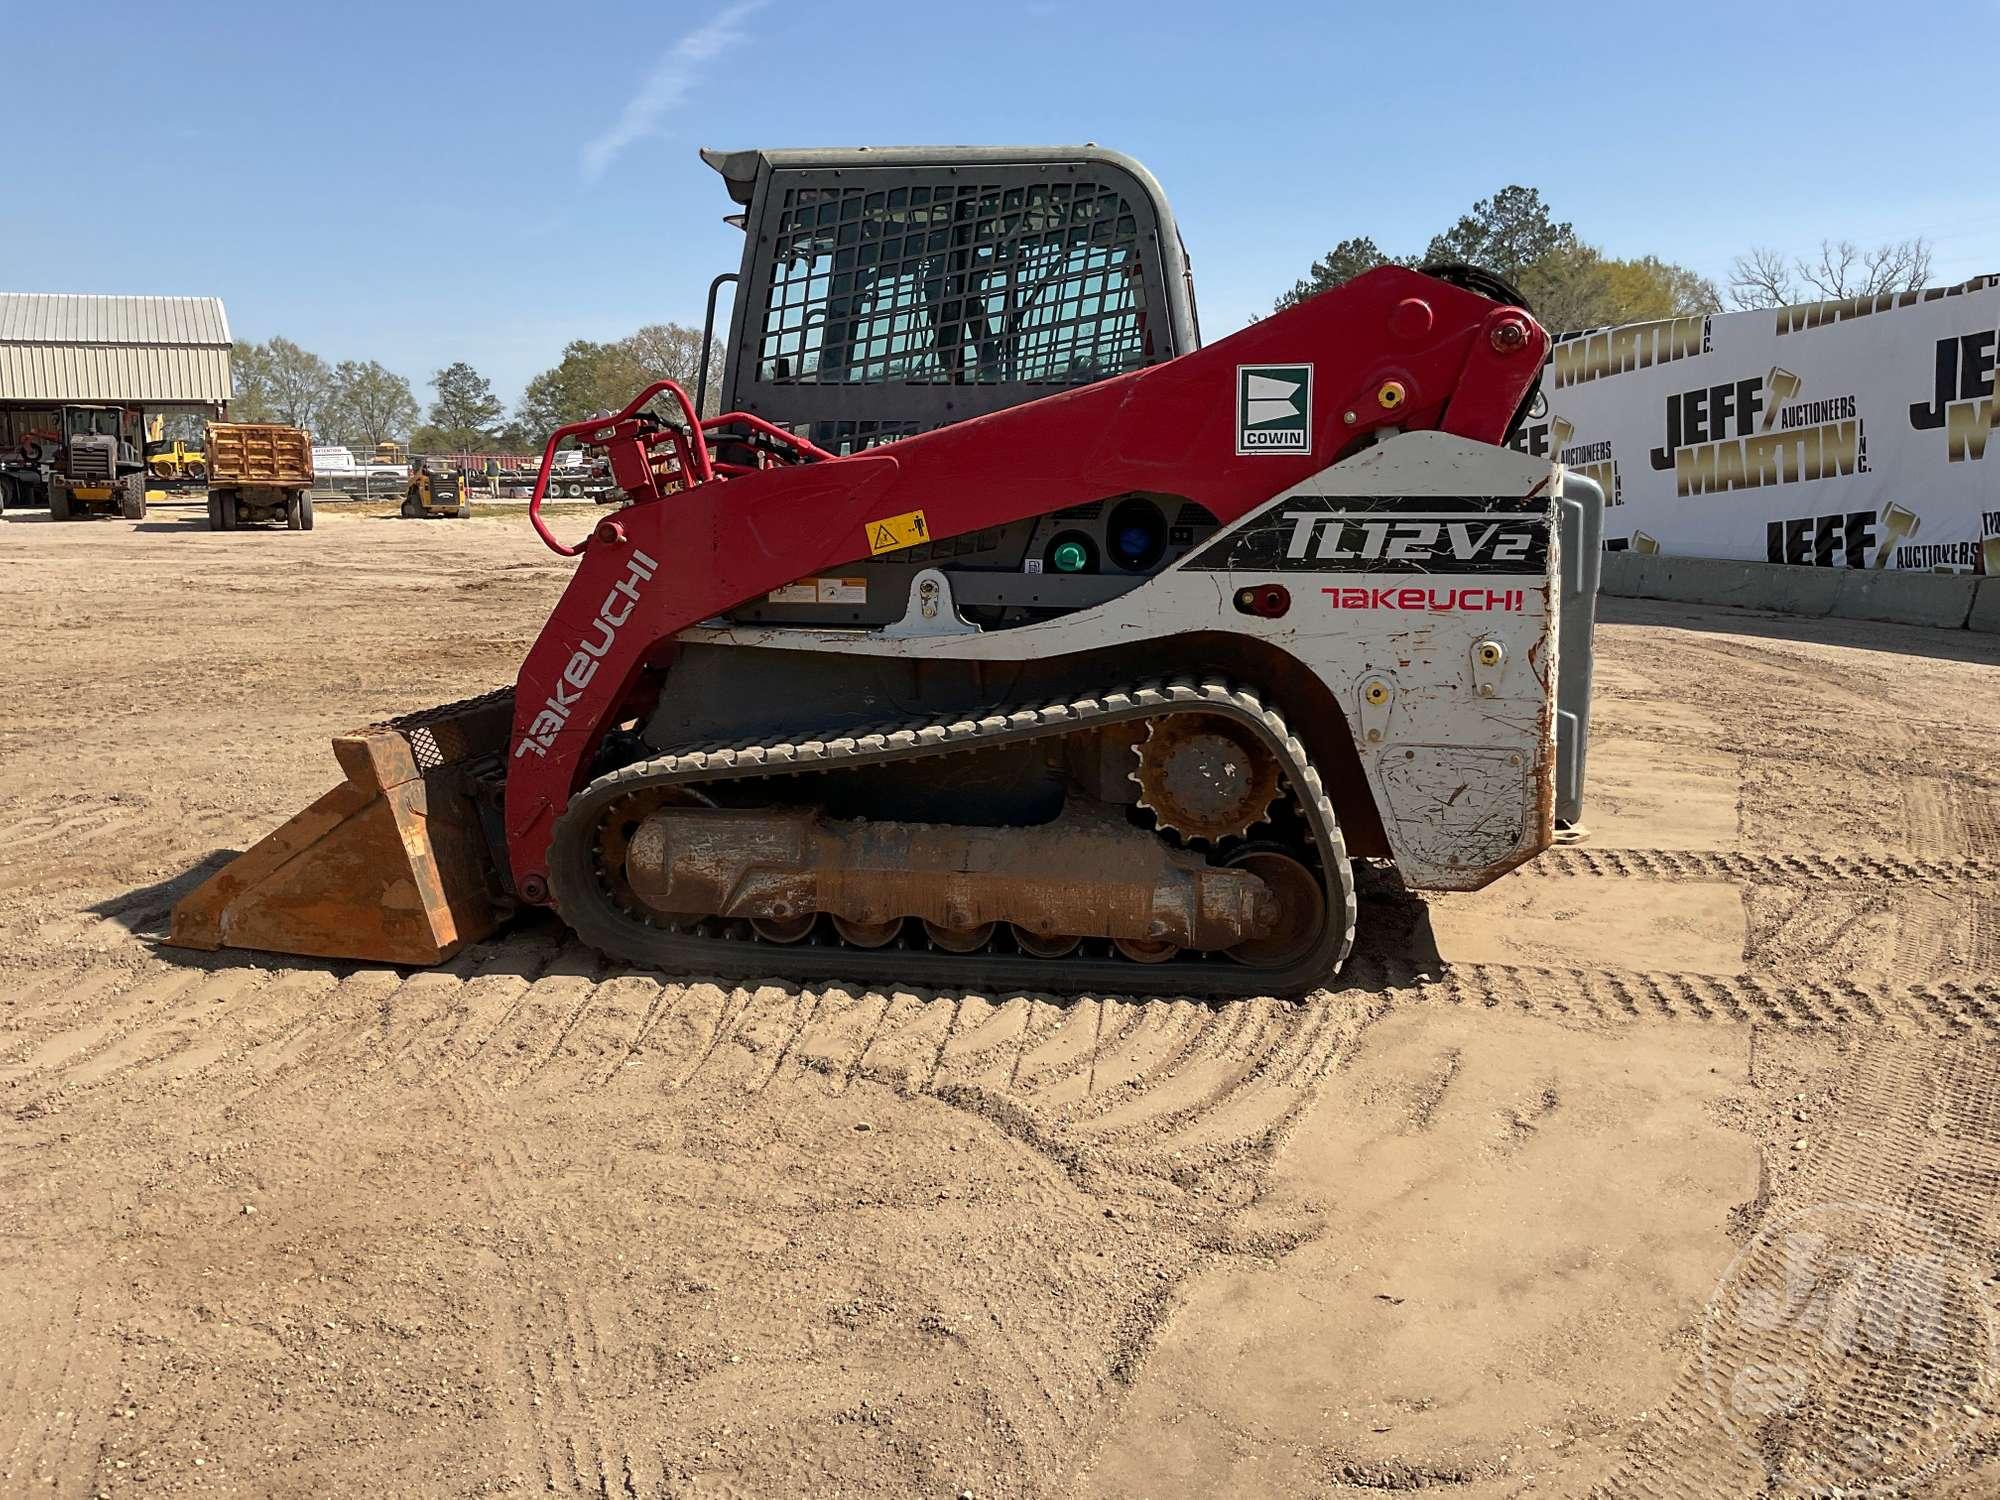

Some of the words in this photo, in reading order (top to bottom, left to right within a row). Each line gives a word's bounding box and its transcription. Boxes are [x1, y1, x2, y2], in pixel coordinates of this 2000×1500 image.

[1651, 376, 1763, 470] JEFF
[1781, 395, 1856, 429] AUCTIONEERS
[1246, 431, 1301, 445] COWIN
[1561, 441, 1612, 467] AUCTIONEERS
[1677, 420, 1856, 498] MARTIN
[1858, 418, 1872, 473] INC.
